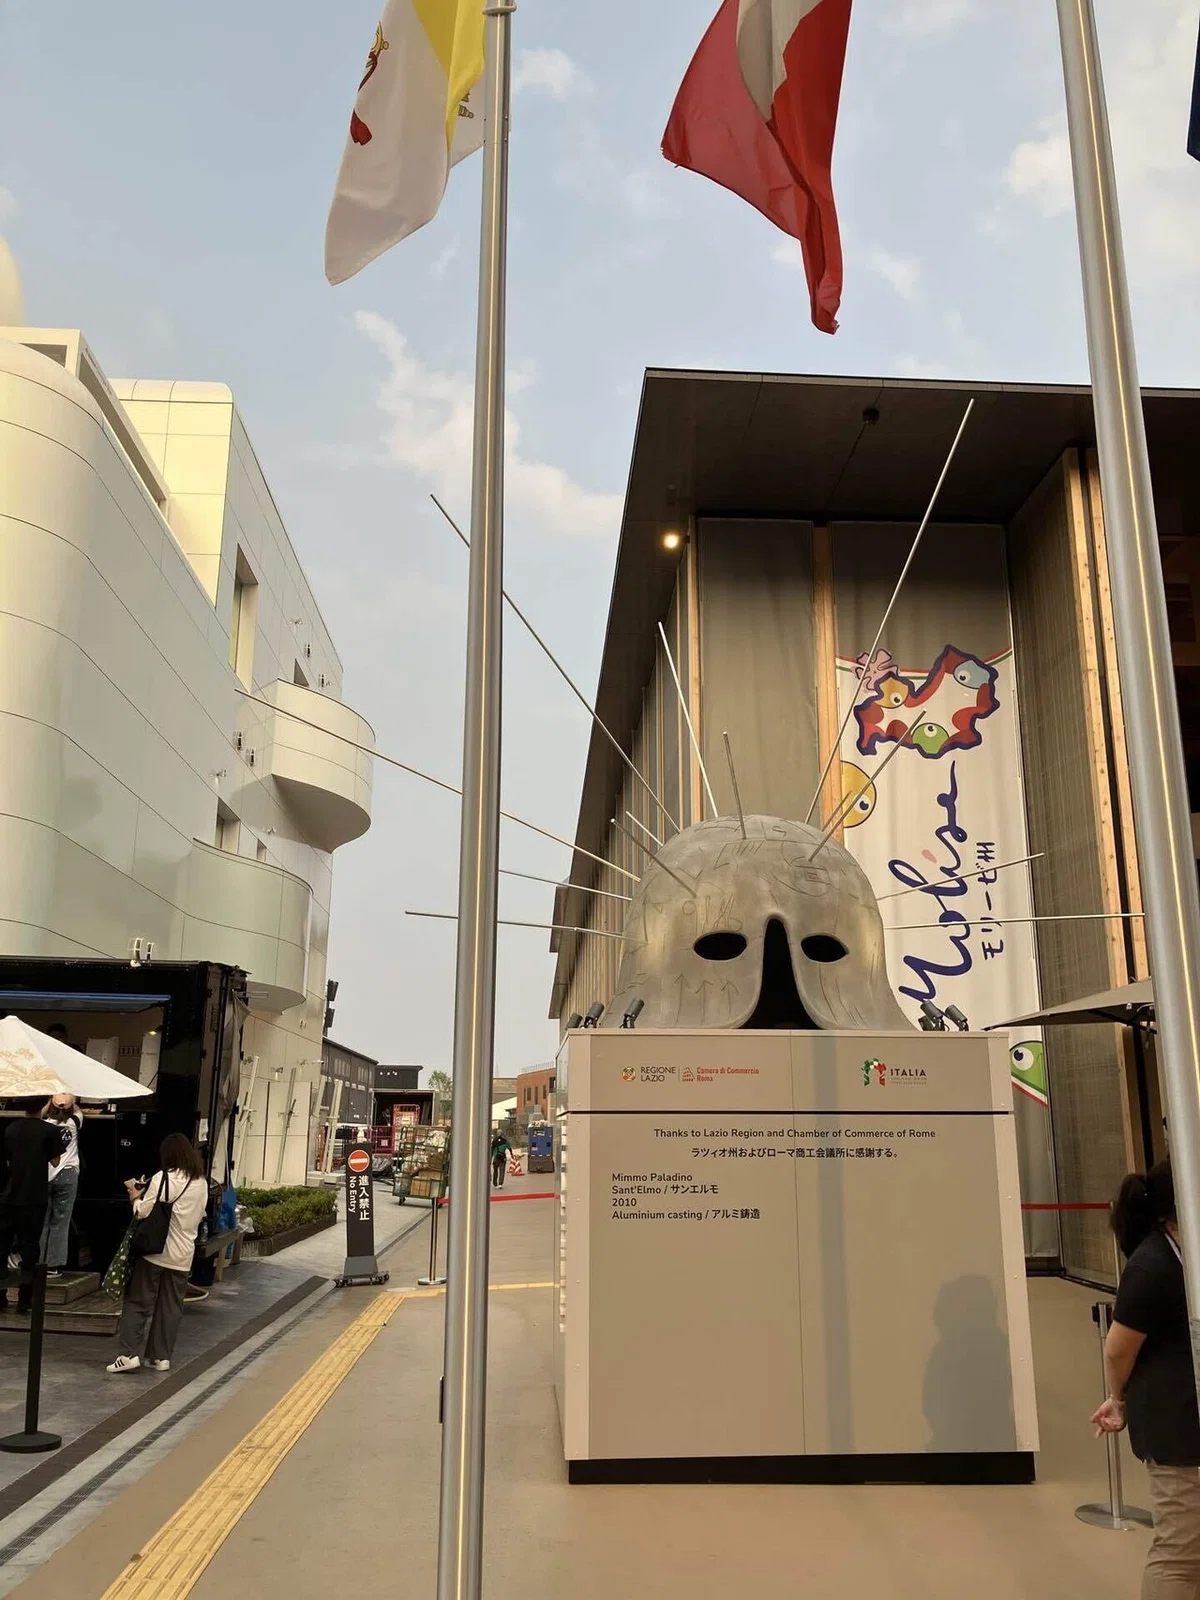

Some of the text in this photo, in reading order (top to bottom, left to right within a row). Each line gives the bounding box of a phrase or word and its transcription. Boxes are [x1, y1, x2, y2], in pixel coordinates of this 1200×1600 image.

[640, 1066, 676, 1074] REGIONE
[654, 1129, 936, 1139] Thanks to Lazio Region and Chamber of Commerce of Rome
[691, 1147, 898, 1158] ラツィオ州およびローマ商工会議所に感謝する。
[612, 1173, 693, 1182] Mimmo Paladino
[348, 1176, 357, 1213] No Entry
[612, 1186, 662, 1195] Sant'Elmo
[671, 1184, 719, 1194] サンエルモ
[359, 1175, 370, 1221] 進入禁止
[612, 1198, 637, 1207] 2010
[612, 1210, 665, 1219] Aluminium
[667, 1210, 703, 1220] casting
[712, 1208, 760, 1219] アルミ鋳造
